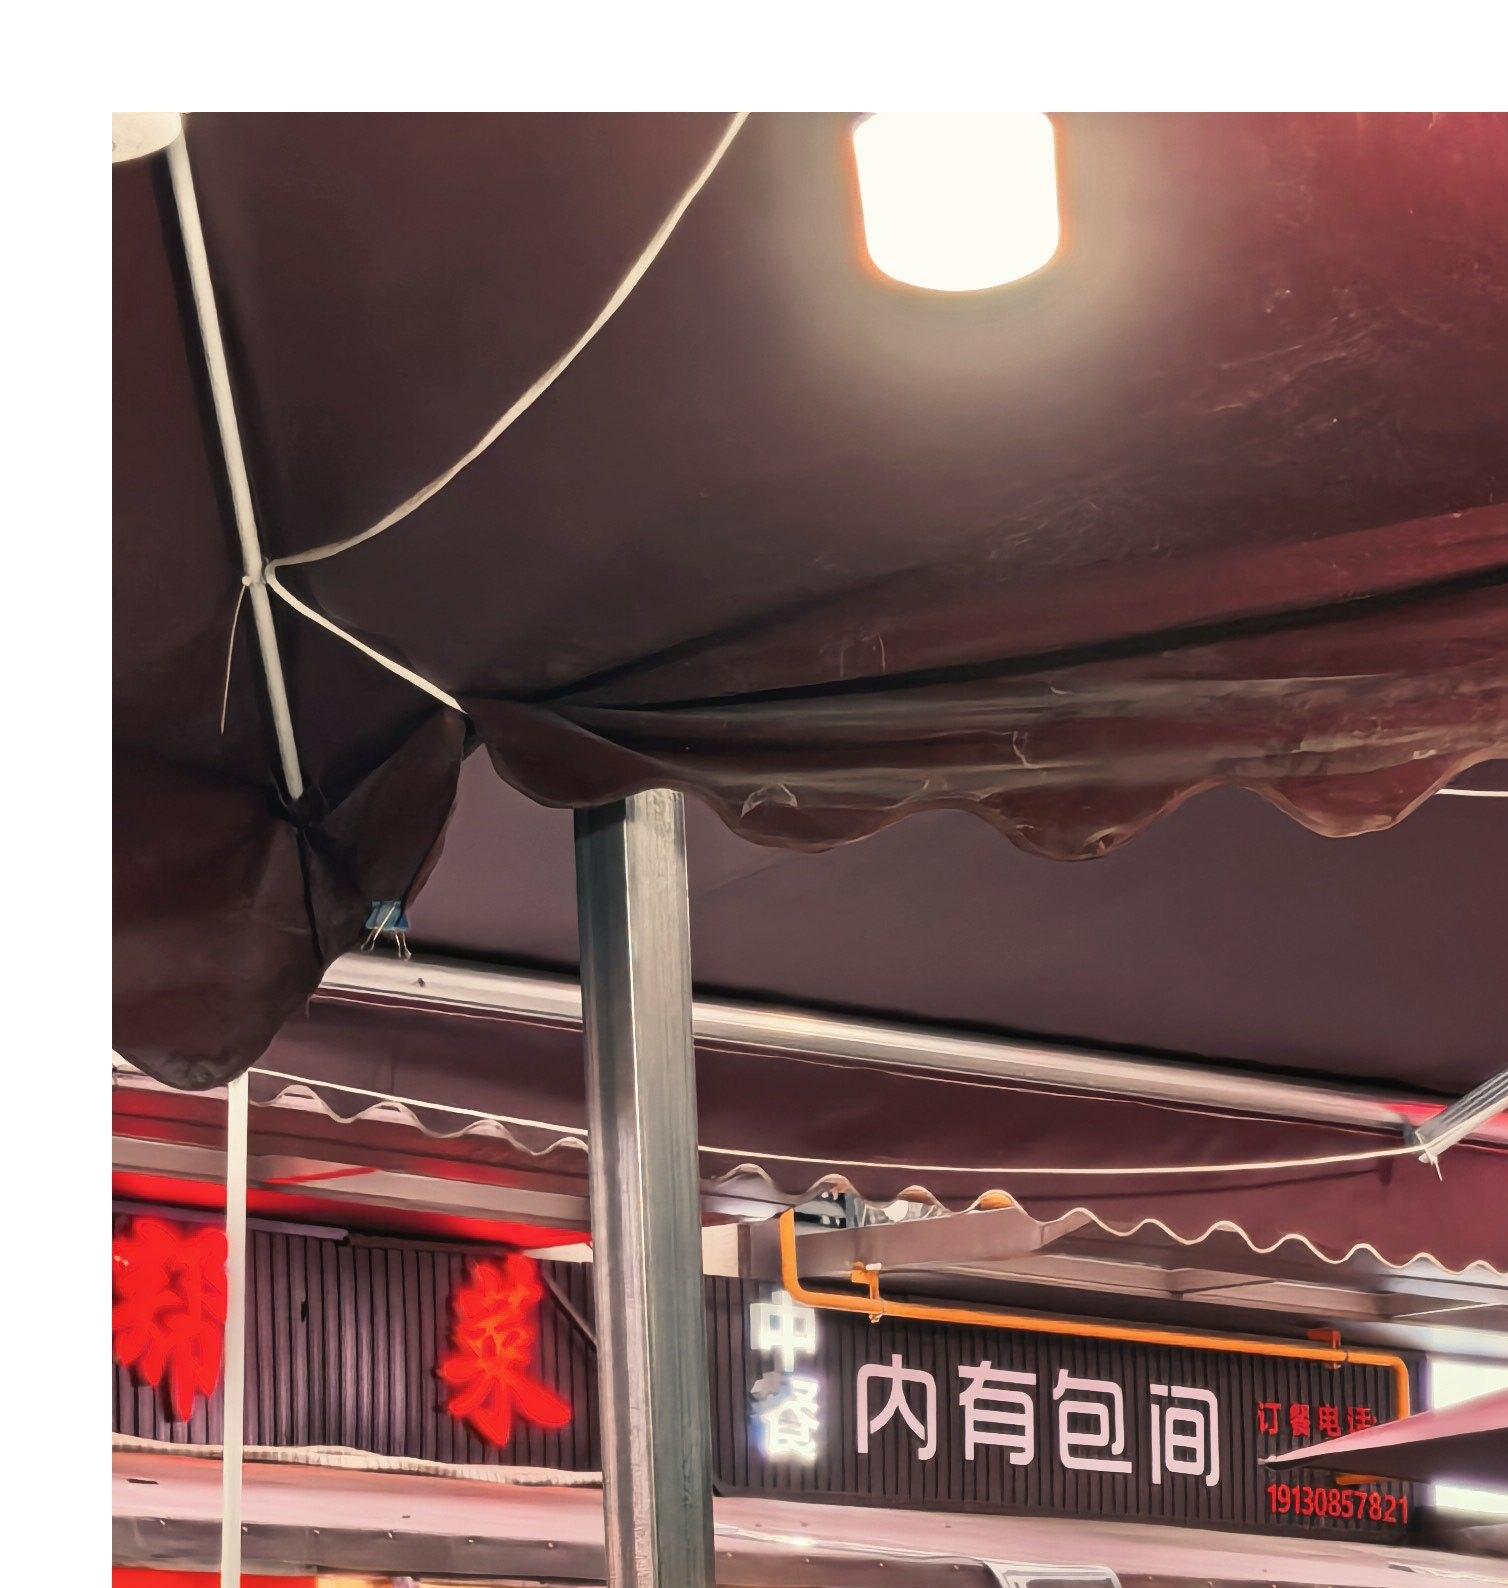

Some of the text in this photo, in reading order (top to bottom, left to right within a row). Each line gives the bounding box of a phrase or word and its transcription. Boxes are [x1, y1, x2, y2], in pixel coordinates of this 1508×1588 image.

[750, 1290, 820, 1461] 中餐
[856, 1353, 1220, 1487] 内有包间
[1258, 1401, 1376, 1438] 订餐电话
[1267, 1483, 1409, 1528] 19130857821
